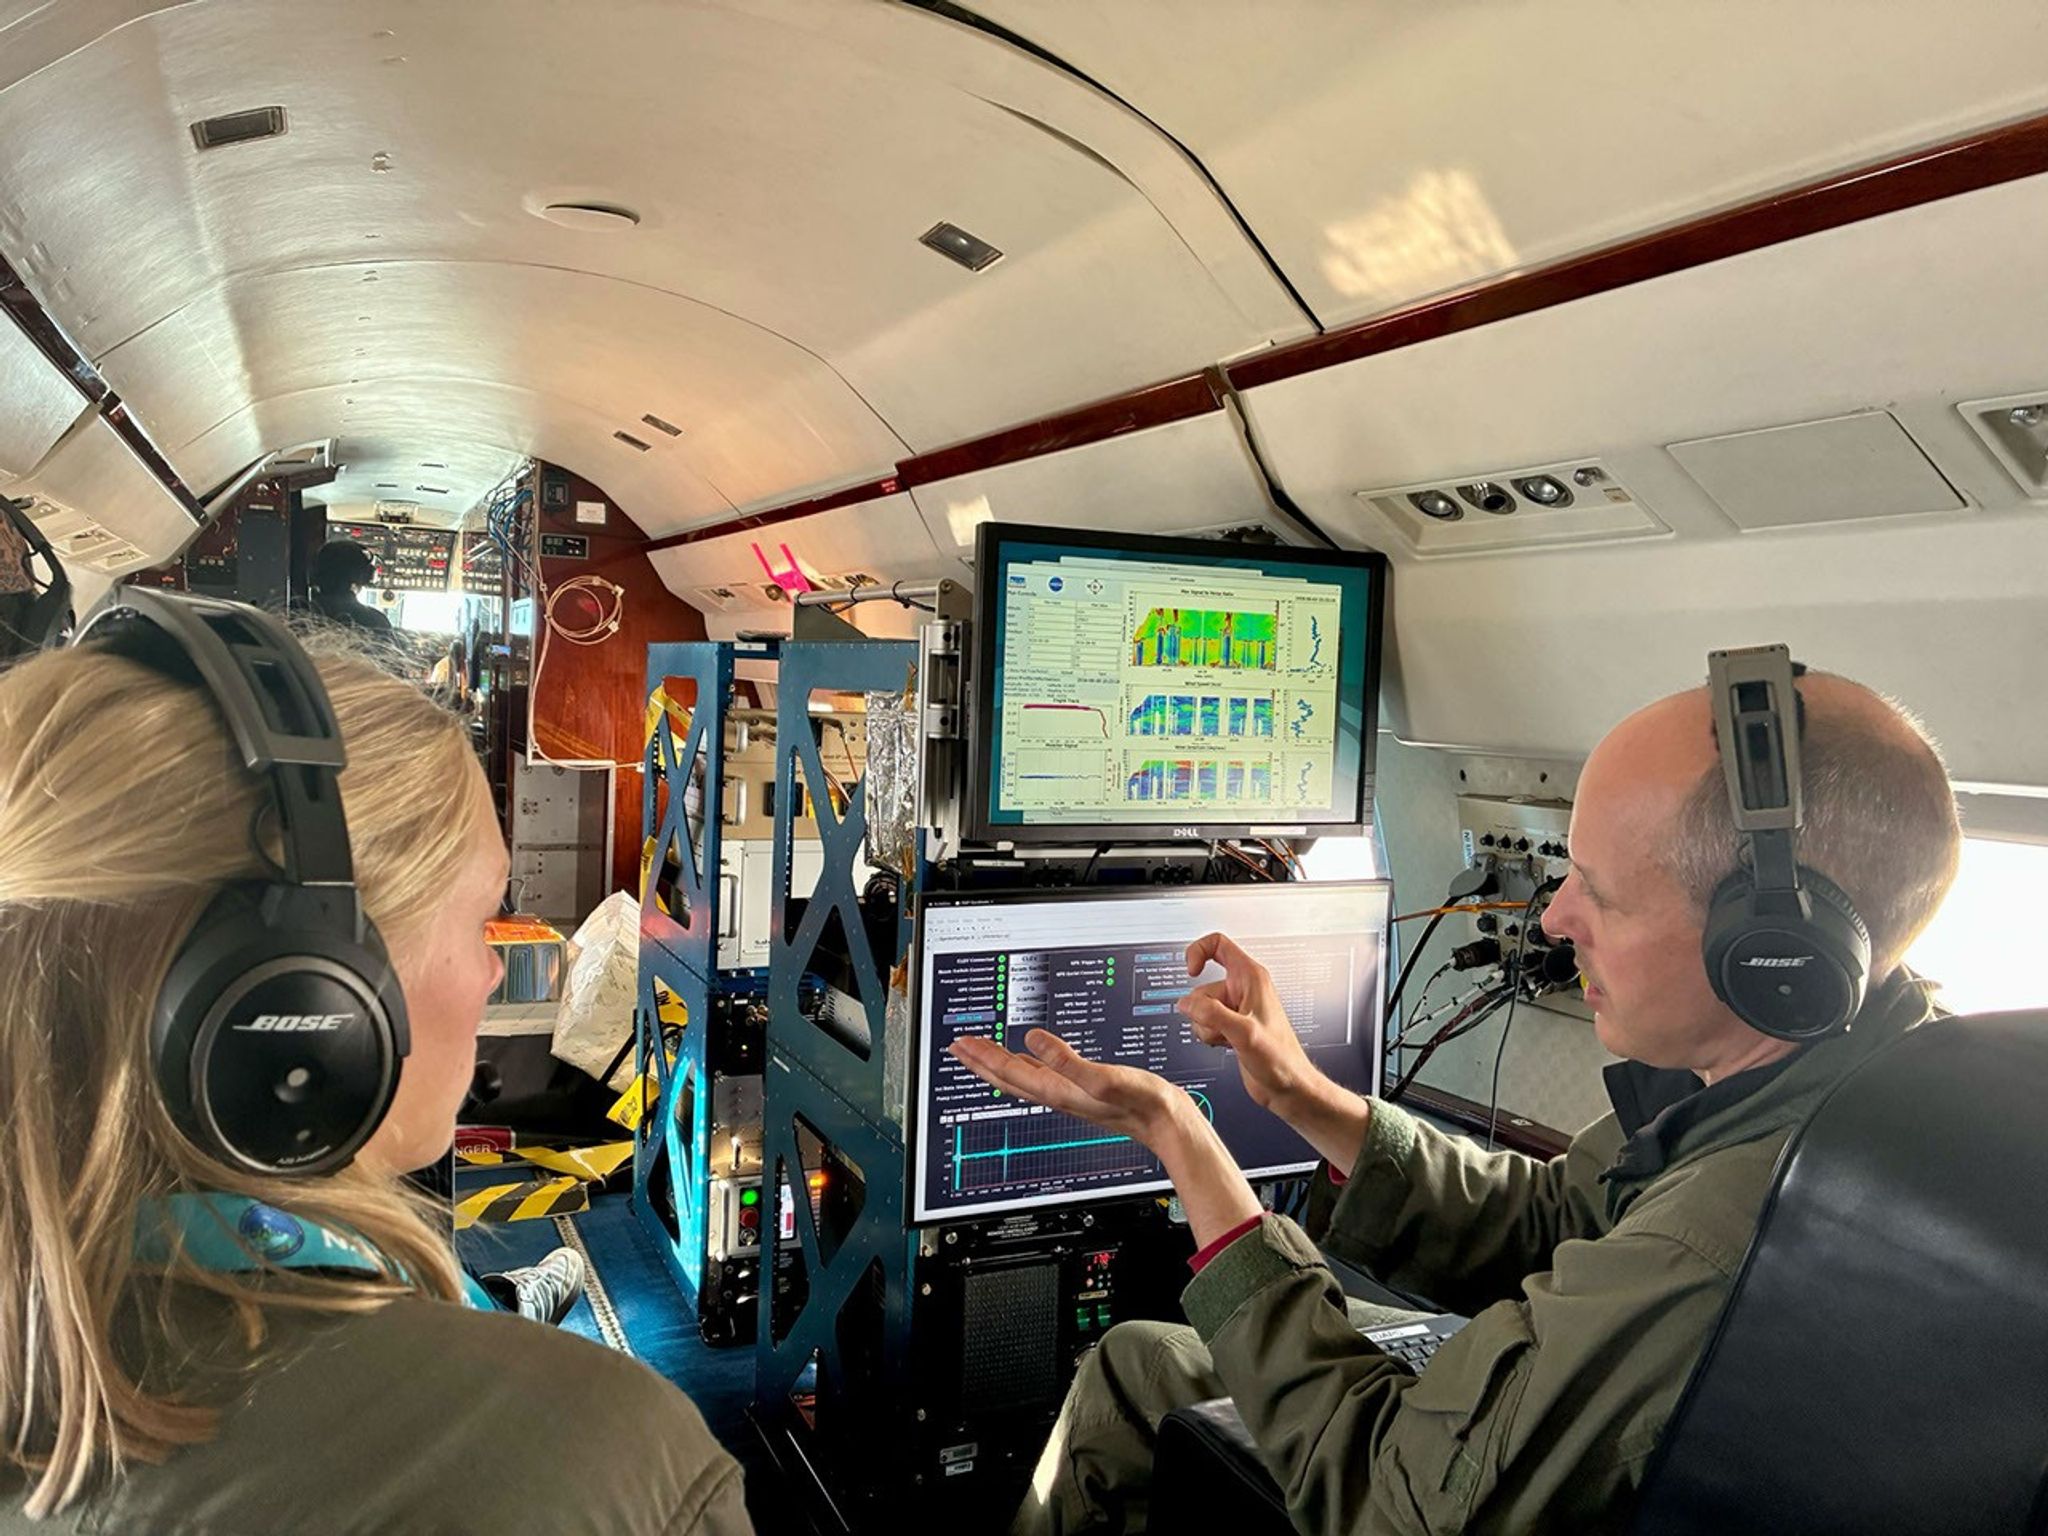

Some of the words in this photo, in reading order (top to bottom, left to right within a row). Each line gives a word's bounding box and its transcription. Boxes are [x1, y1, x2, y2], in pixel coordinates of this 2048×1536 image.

[1173, 828, 1199, 837] DELL
[1740, 955, 1814, 968] BOSE
[234, 1014, 354, 1032] BOSE
